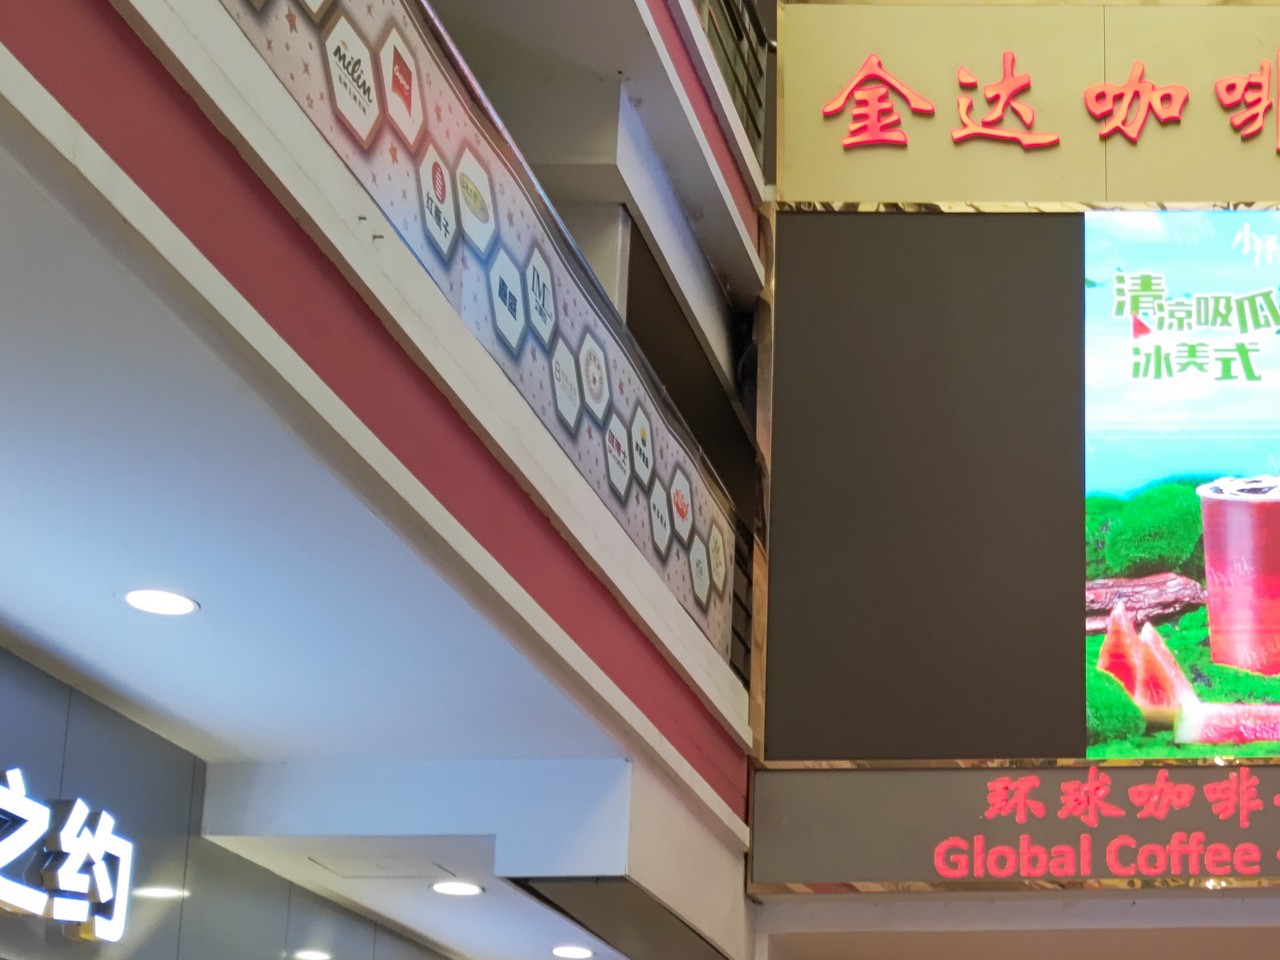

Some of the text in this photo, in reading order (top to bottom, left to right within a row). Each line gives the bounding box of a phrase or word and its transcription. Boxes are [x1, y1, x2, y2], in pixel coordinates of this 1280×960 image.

[1131, 341, 1262, 382] 冰美式
[934, 834, 1092, 879] Global
[1106, 831, 1262, 877] Coffee
